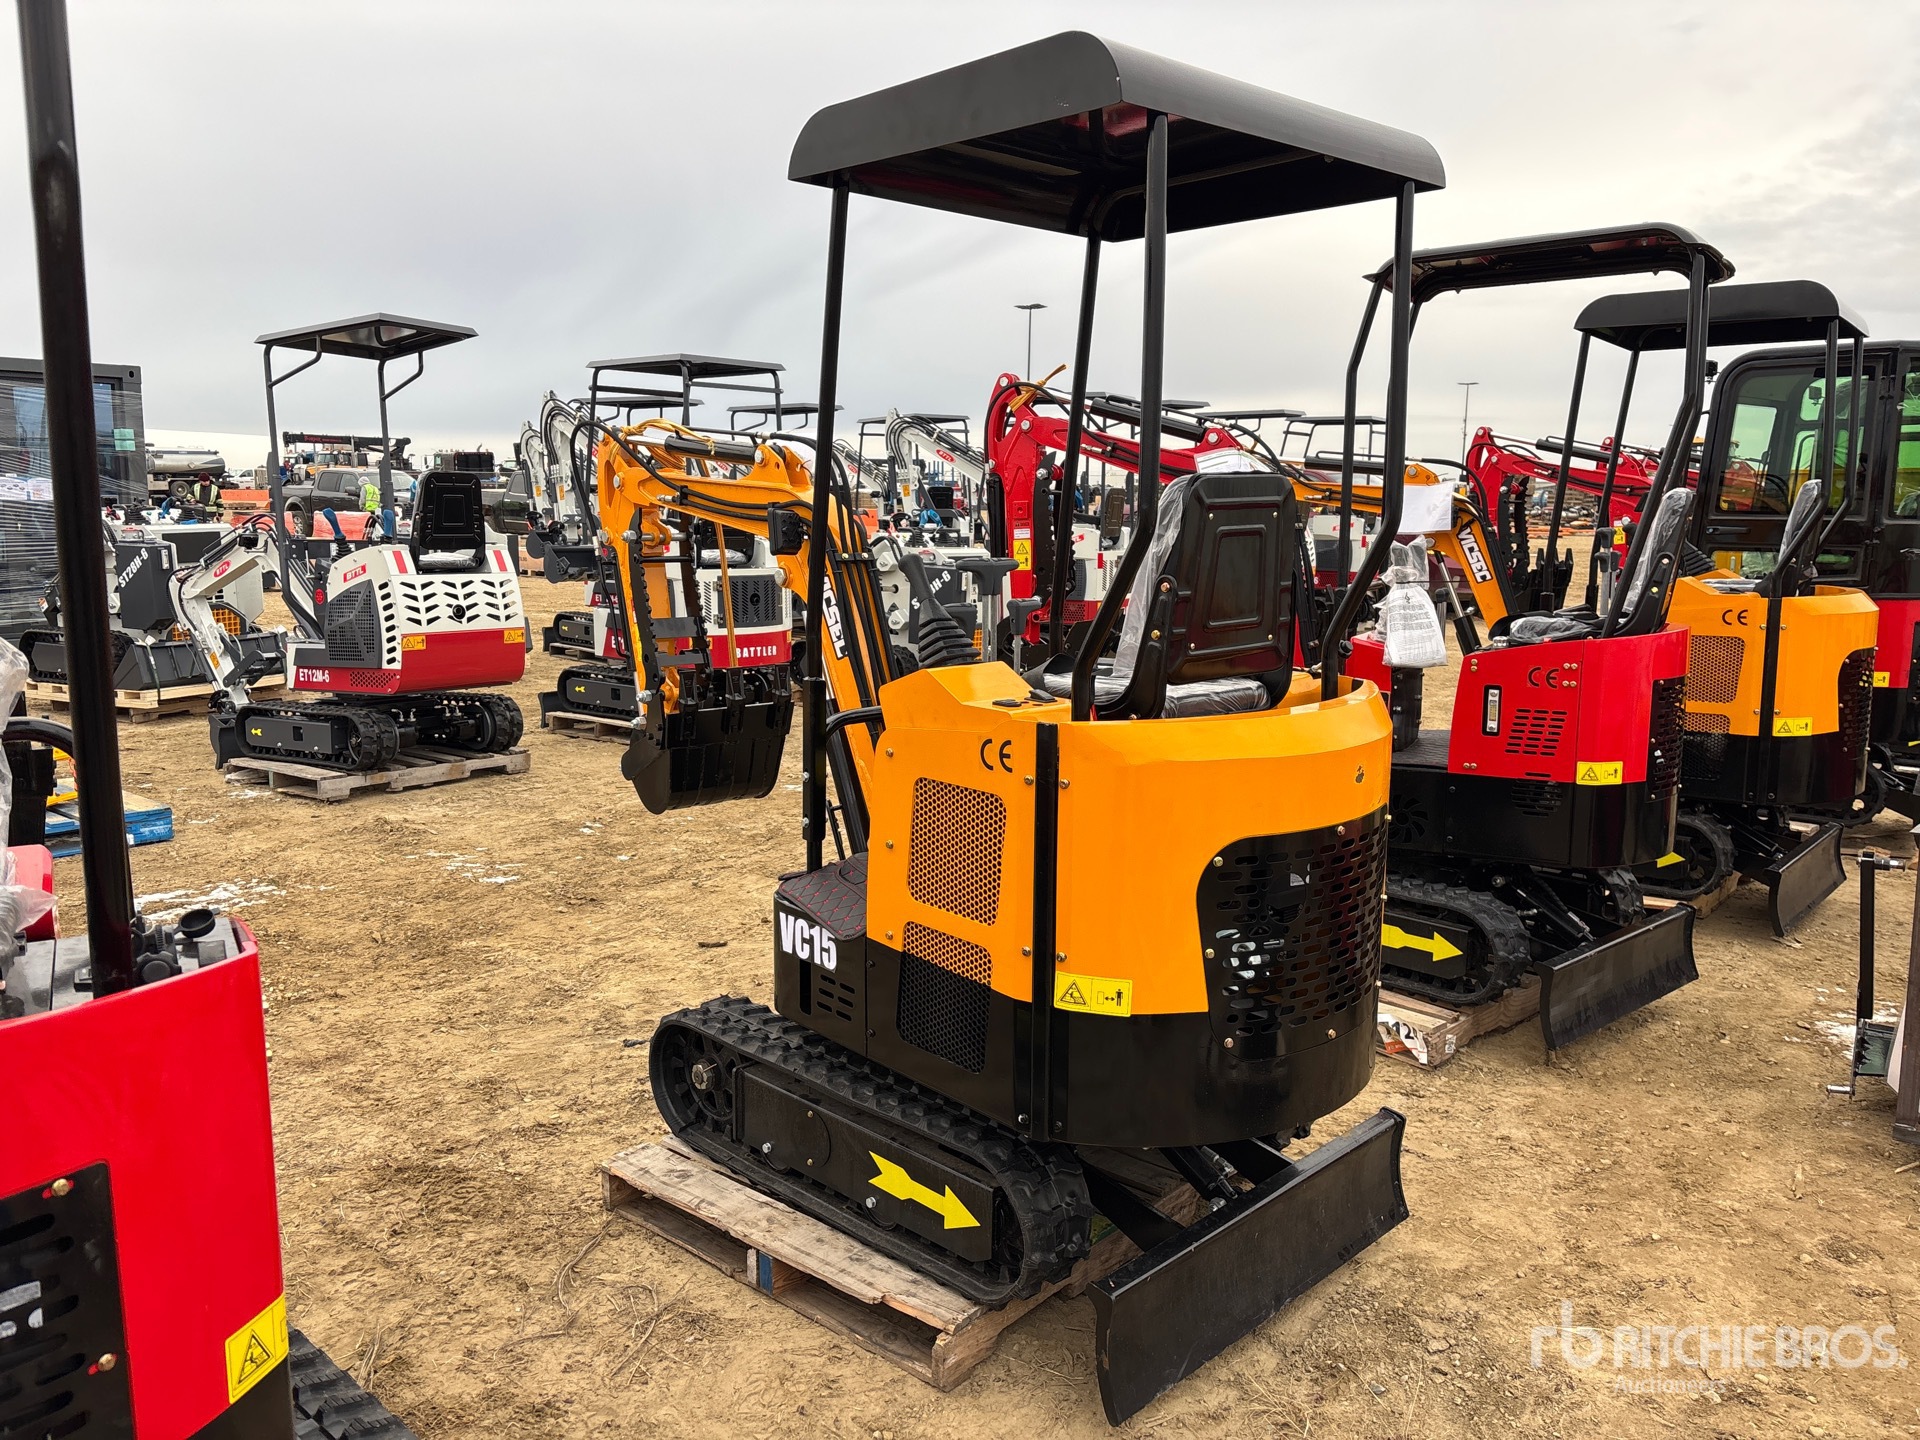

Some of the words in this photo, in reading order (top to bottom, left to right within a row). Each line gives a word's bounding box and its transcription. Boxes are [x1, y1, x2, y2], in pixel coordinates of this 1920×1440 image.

[118, 547, 149, 588] ST28H-6
[346, 567, 364, 580] BTTL
[1722, 609, 1748, 626] CE
[735, 645, 777, 658] BATTLER
[299, 669, 330, 683] ET12M-6
[1527, 666, 1560, 689] CE
[980, 738, 1013, 773] CE
[779, 911, 837, 970] VC15
